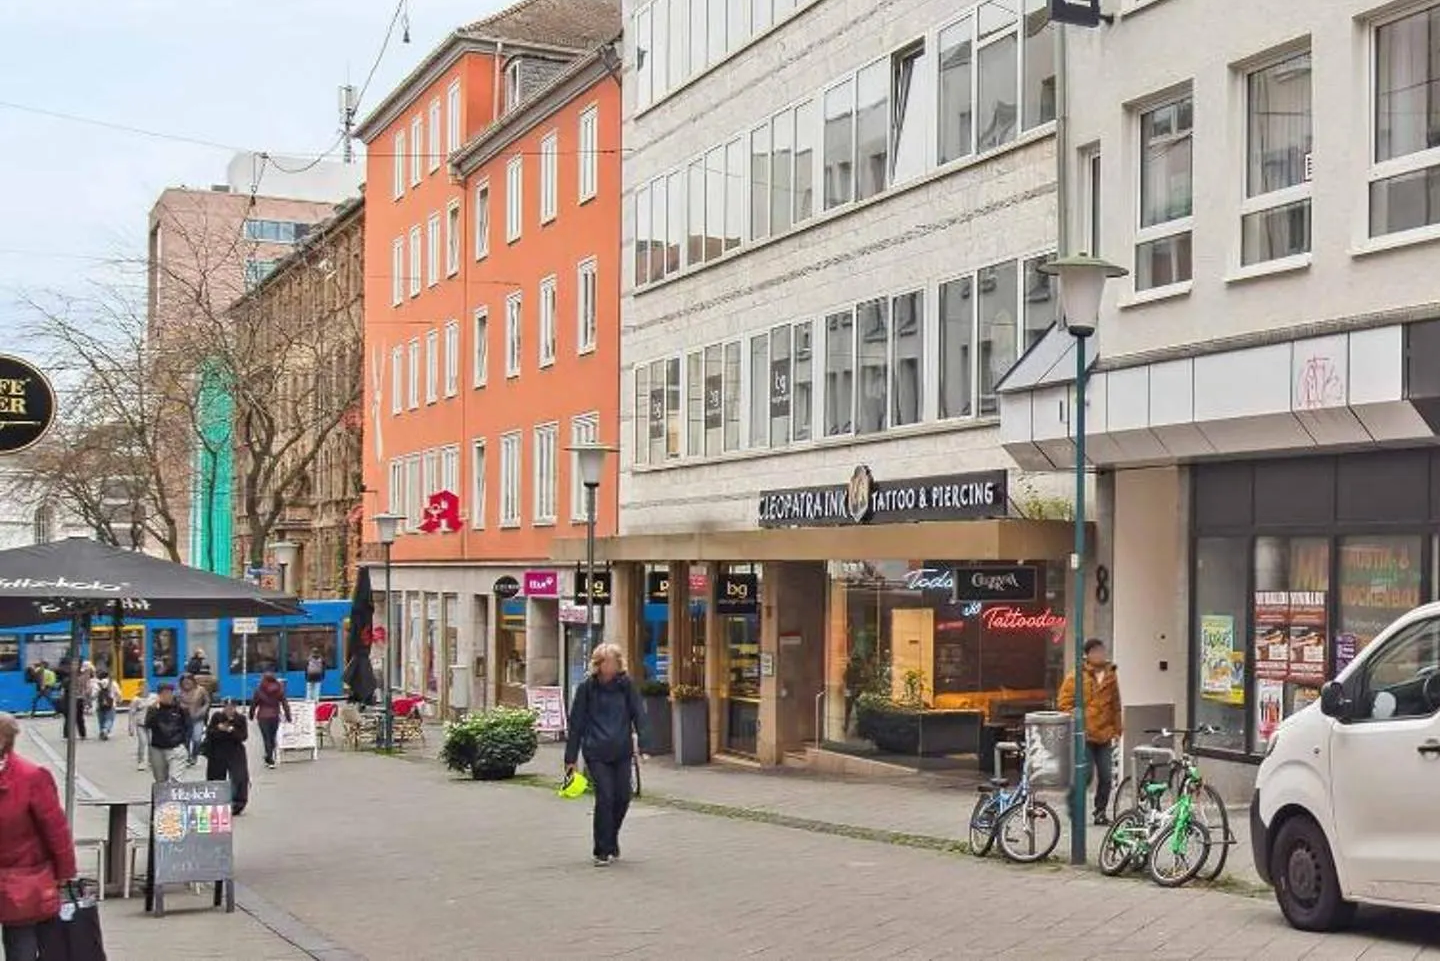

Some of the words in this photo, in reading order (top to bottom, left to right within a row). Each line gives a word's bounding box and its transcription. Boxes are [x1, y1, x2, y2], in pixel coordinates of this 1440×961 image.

[759, 490, 823, 521] CLEOPATRA
[824, 490, 848, 518] INK
[871, 487, 915, 512] TATTOO
[918, 488, 928, 509] &
[931, 482, 994, 508] PIERCING
[727, 582, 748, 598] bg
[1095, 564, 1110, 606] 8
